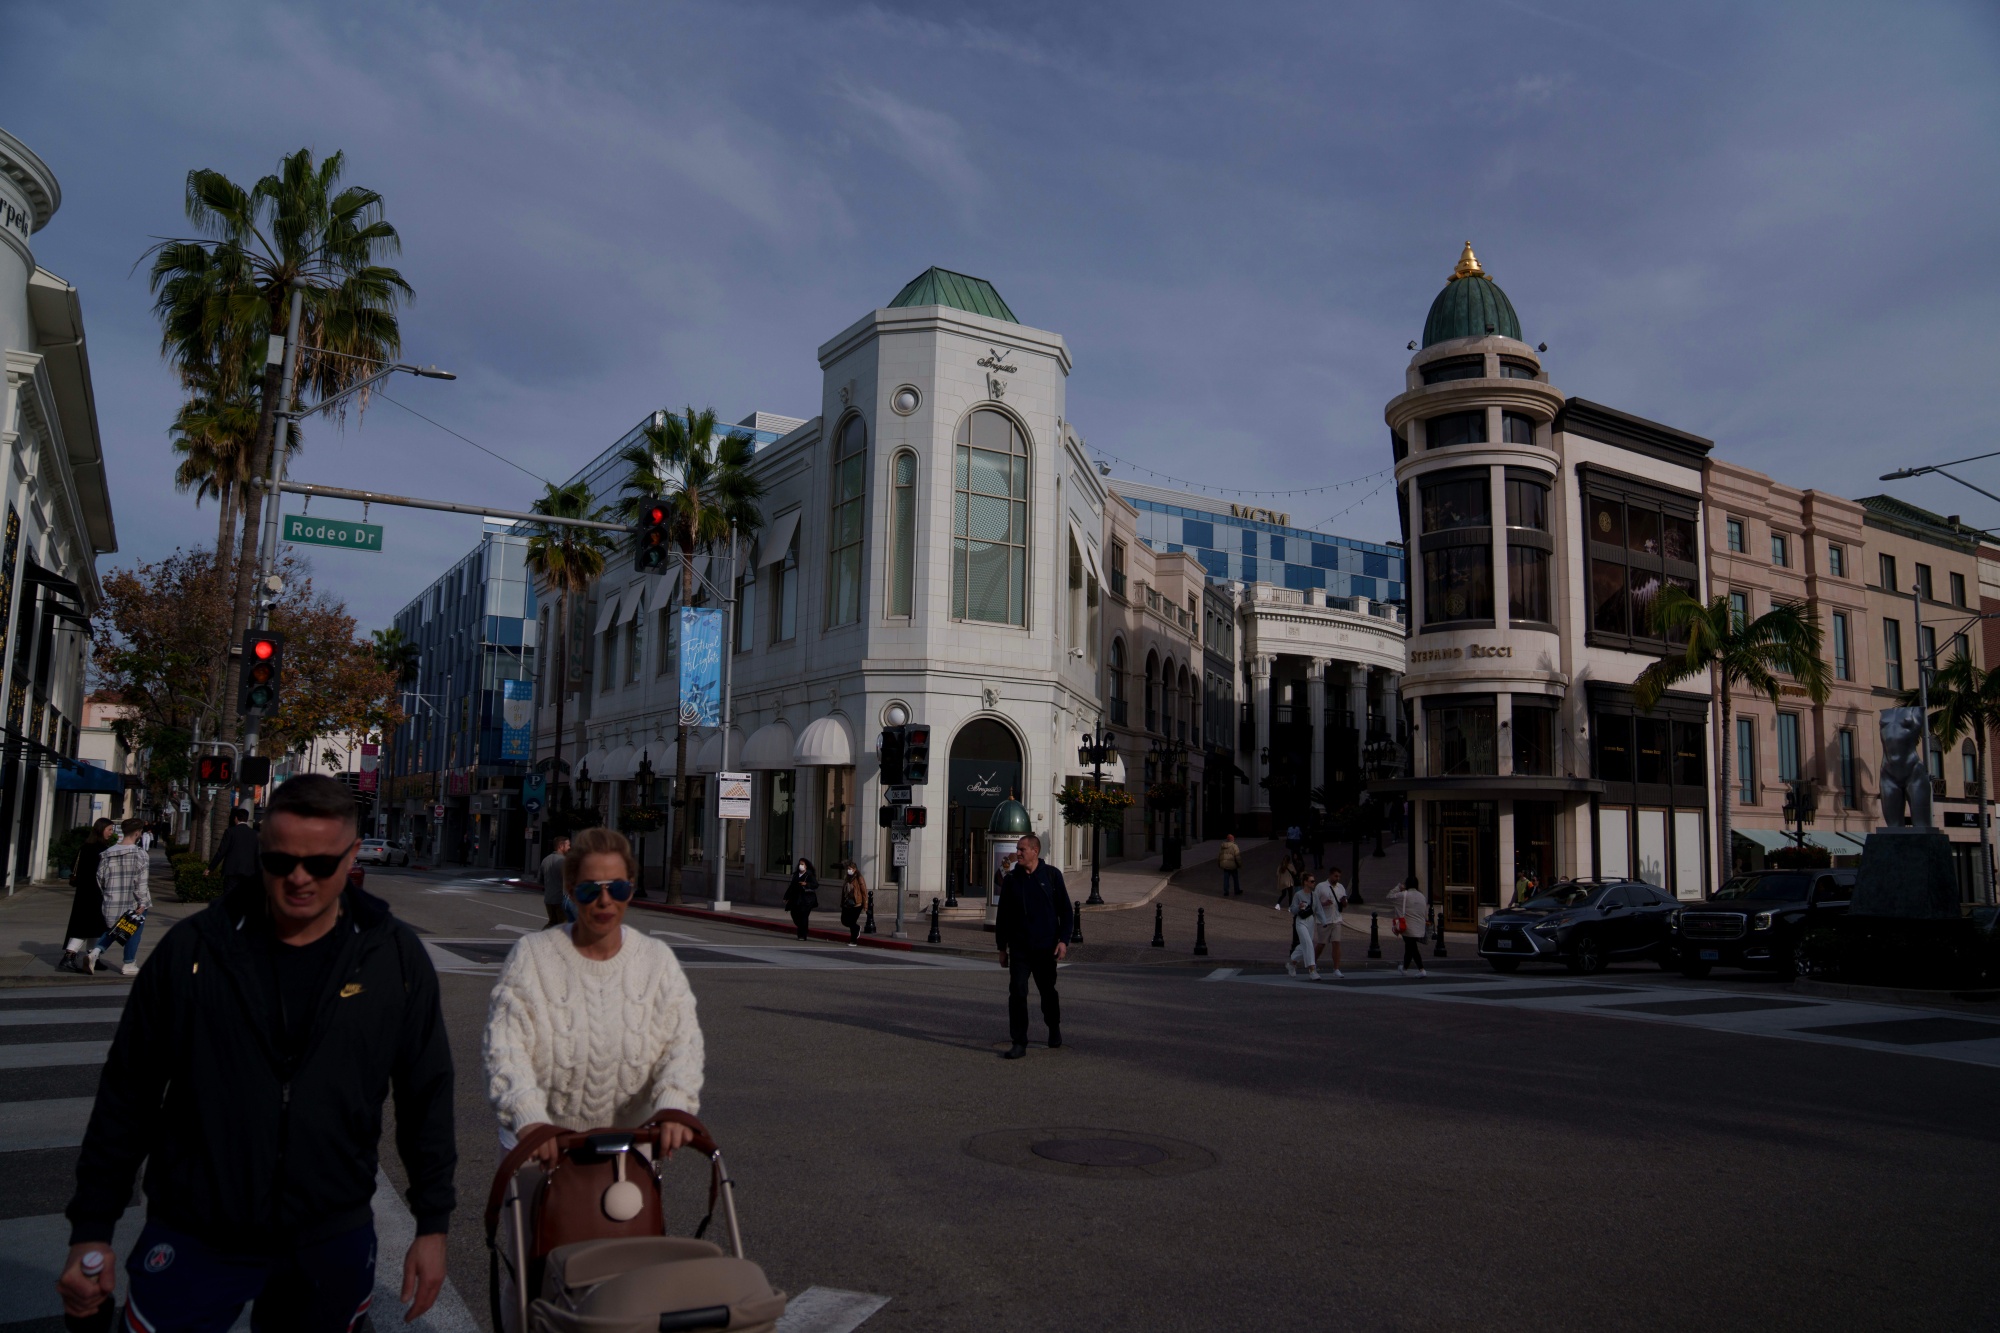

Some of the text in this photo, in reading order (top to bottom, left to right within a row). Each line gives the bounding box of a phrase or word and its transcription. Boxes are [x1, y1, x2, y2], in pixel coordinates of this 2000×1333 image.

[1231, 503, 1287, 526] MGM
[291, 521, 375, 545] Rodeo Dr
[680, 635, 721, 656] Festival
[1411, 643, 1513, 663] STEFANO RICCI
[692, 649, 719, 674] Lights
[220, 762, 229, 780] 6
[530, 775, 541, 786] P
[891, 790, 909, 799] ONE WAY
[1964, 813, 1975, 822] IWC
